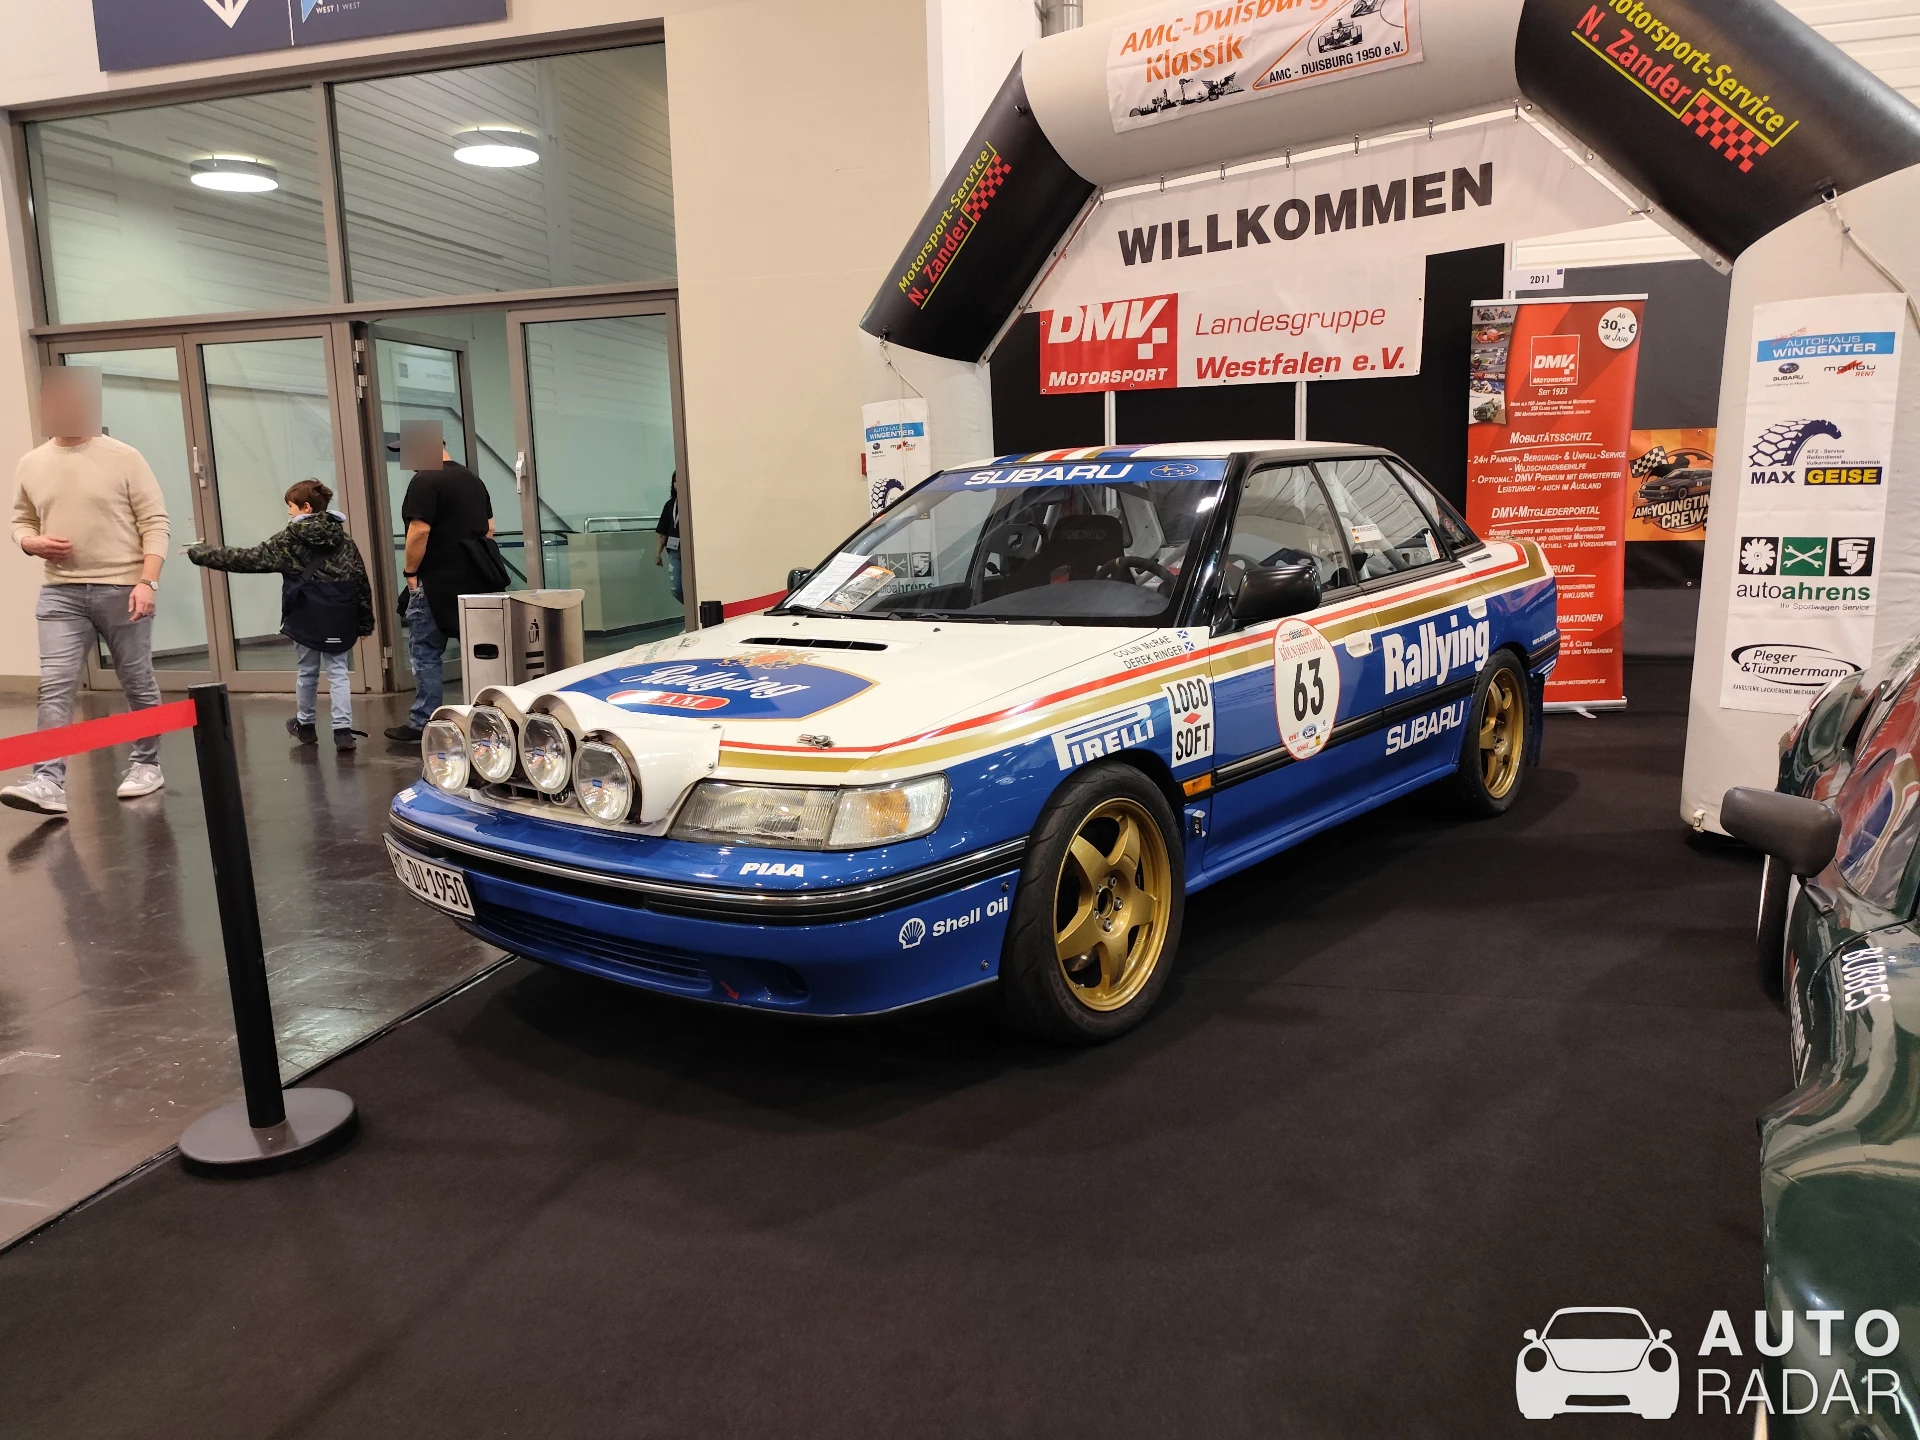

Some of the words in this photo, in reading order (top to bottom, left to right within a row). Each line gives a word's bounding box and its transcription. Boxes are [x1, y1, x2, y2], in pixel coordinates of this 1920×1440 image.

[315, 5, 335, 14] WEST
[341, 2, 360, 10] WEST
[1145, 34, 1245, 84] Klassik
[1269, 69, 1292, 84] AMC
[1301, 52, 1354, 76] DUISBURG
[1357, 47, 1382, 63] 1950
[1384, 41, 1404, 58] e.V.
[1576, 5, 1606, 43] N.
[1605, 28, 1692, 105] Zander
[1609, 0, 1785, 133] otorsport-Service
[898, 149, 989, 293] Motorsport-Service
[1118, 161, 1494, 267] WILLKOMMEN
[907, 286, 929, 307] N.
[922, 216, 968, 284] Zander
[1530, 275, 1550, 284] 2D11
[1048, 299, 1168, 344] DMV
[1195, 307, 1386, 337] Landesgruppe
[1773, 343, 1876, 358] WINGENTER
[1785, 335, 1860, 347] AUTOHAUS
[1196, 351, 1341, 380] Westfalen
[1352, 346, 1405, 372] e.V.
[1533, 354, 1576, 369] DMV
[1048, 367, 1168, 387] MOTORSPORT
[1533, 376, 1575, 384] MOTORSPORT
[1552, 387, 1568, 396] 1923
[1564, 452, 1570, 461] &
[964, 464, 1134, 486] SUBARU
[1515, 473, 1534, 483] DMV
[1751, 471, 1796, 485] MAX
[1807, 469, 1877, 484] GEISE
[1491, 506, 1600, 519] DMV-MITGLIEDERPORTAL
[1662, 508, 1704, 529] CREW
[1061, 529, 1106, 540] RECARO
[1736, 582, 1871, 600] autoahrens
[1793, 603, 1839, 611] Sportwagen
[1113, 645, 1142, 658] COLIN
[1142, 635, 1172, 650] McRAE
[1123, 655, 1154, 669] DEREK
[1153, 645, 1185, 660] RINGER
[1382, 614, 1489, 695] Rallying
[1753, 650, 1797, 664] Pleger
[620, 665, 811, 699] Rallying
[1293, 657, 1325, 722] 63
[1167, 678, 1209, 715] LOCO
[1050, 704, 1155, 771] PIRELLI
[1386, 700, 1465, 756] SUBARU
[1175, 723, 1210, 761] SOFT
[739, 862, 804, 877] PIAA
[426, 867, 469, 909] 1950
[932, 907, 980, 937] Shell
[986, 897, 1008, 917] Oil
[1842, 946, 1897, 1011] BÜBBES
